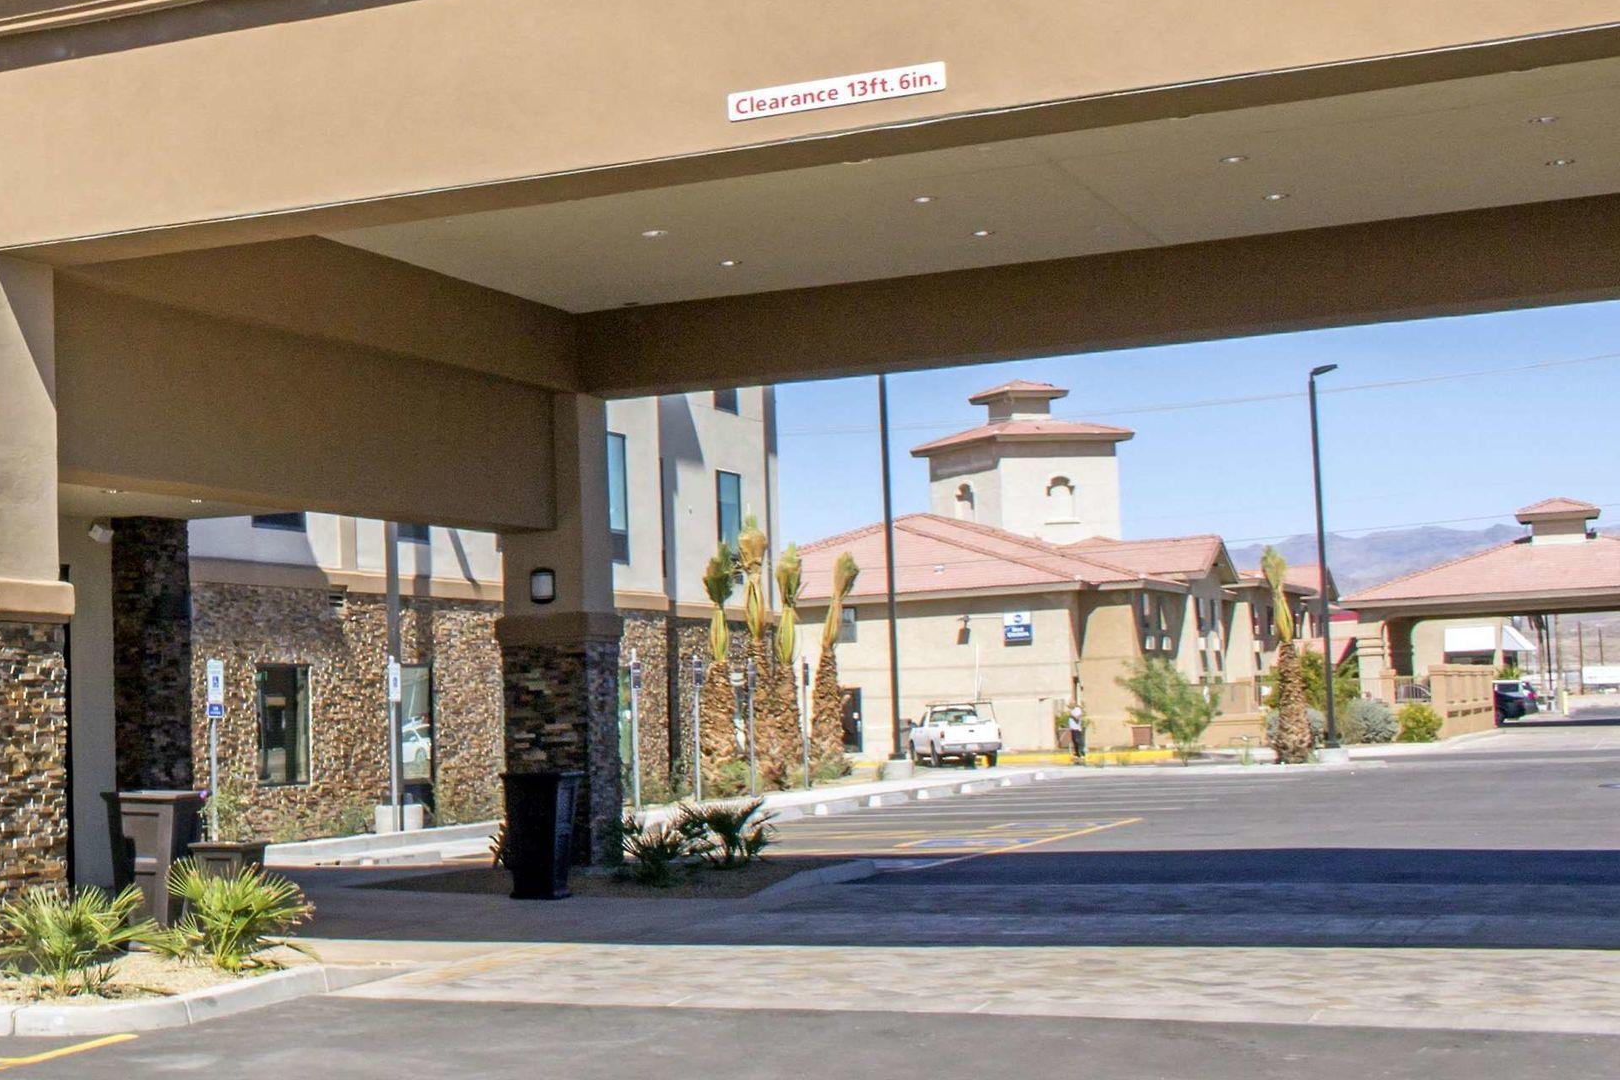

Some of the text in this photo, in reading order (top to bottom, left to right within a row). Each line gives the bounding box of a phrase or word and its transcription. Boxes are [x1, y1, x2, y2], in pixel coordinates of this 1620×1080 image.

[736, 72, 938, 114] Clearance 13ft. 6in.
